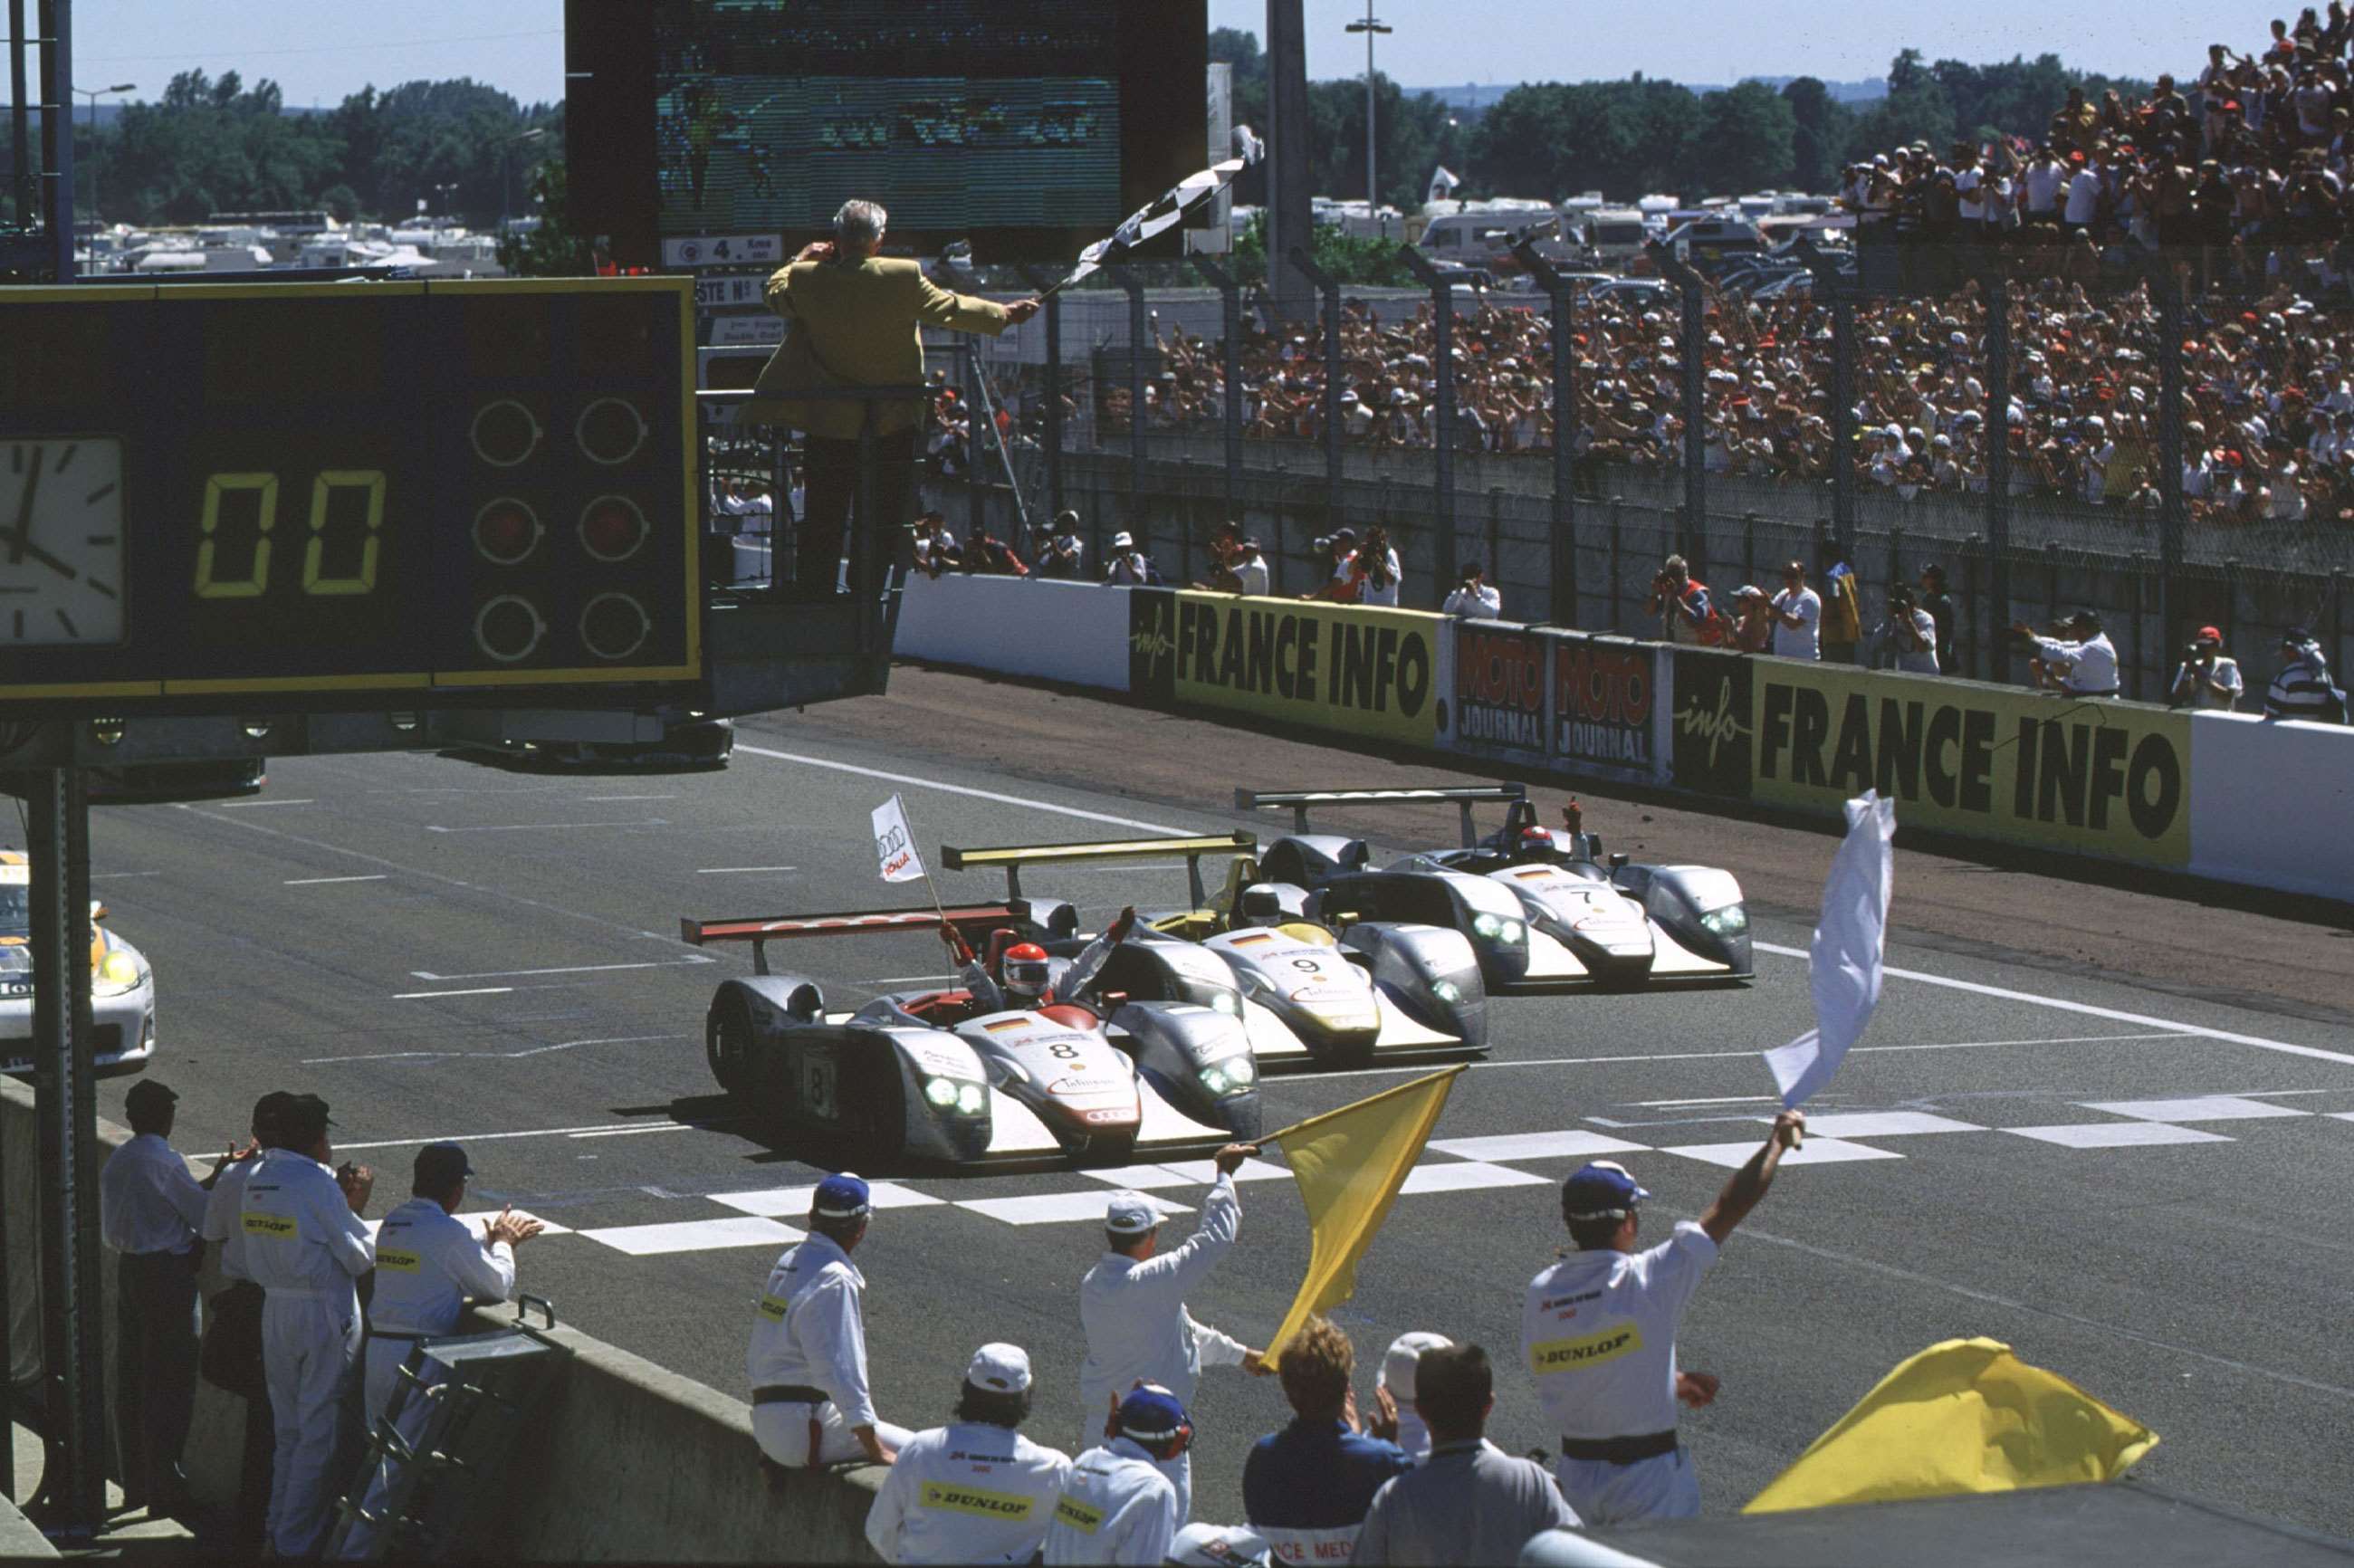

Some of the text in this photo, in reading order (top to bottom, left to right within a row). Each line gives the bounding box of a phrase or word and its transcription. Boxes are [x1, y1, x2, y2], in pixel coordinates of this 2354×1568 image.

[1128, 603, 1175, 680] info
[1176, 601, 1430, 718] FRANCE INFO
[1458, 634, 1543, 712] MOTO
[1557, 645, 1650, 726] MOTO
[1461, 705, 1542, 747] JOURNAL
[1557, 721, 1649, 763] JOURNAL
[1673, 676, 1753, 768] info
[1759, 683, 2181, 839] FRANCE INFO
[1570, 891, 1592, 904] 7
[1292, 960, 1320, 973] 9
[1049, 1044, 1079, 1058] 8
[811, 1067, 823, 1105] 8
[1546, 1333, 1631, 1363] DUNLOP
[943, 1492, 1028, 1514] DUNLOP
